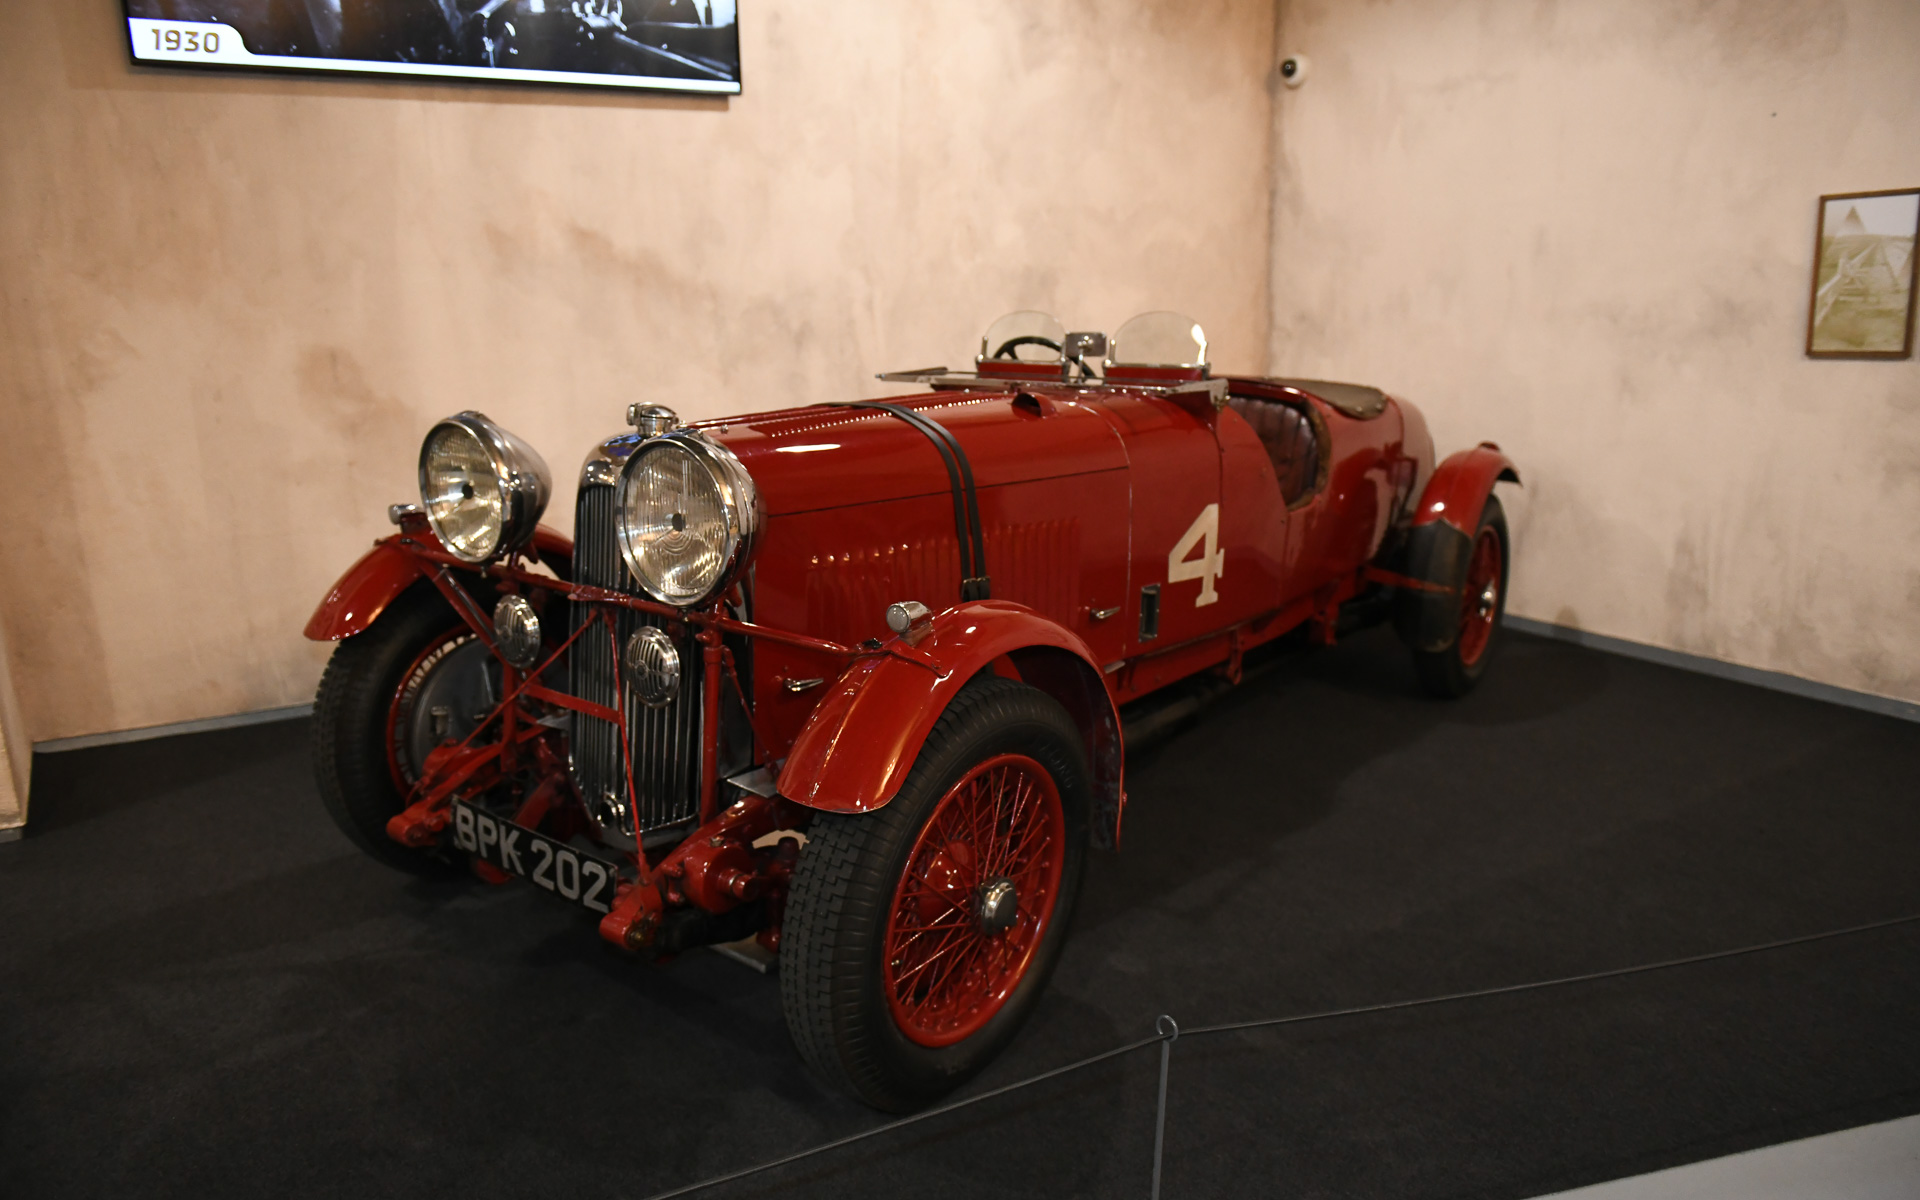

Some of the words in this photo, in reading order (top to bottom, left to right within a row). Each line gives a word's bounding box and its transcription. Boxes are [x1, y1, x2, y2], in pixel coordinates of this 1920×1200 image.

[151, 28, 220, 53] 1930
[1168, 502, 1225, 608] 4
[456, 803, 525, 876] BPK
[531, 839, 610, 914] 202
